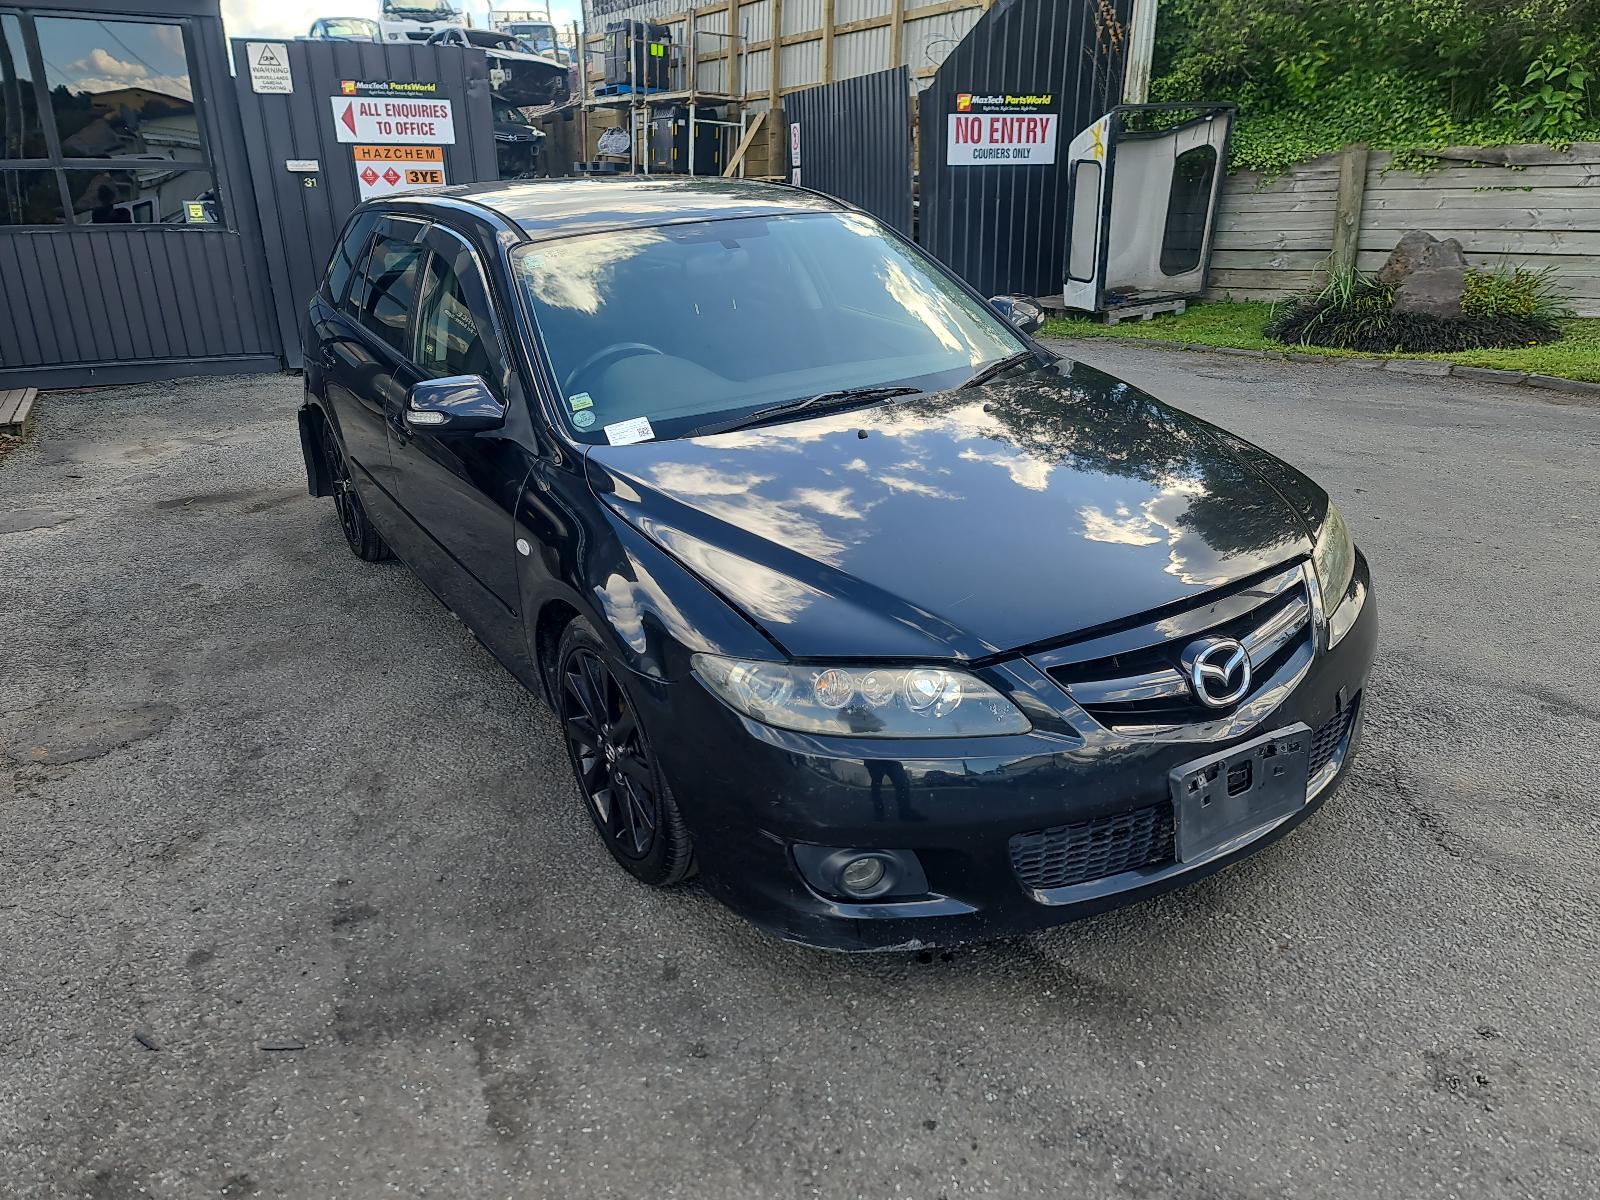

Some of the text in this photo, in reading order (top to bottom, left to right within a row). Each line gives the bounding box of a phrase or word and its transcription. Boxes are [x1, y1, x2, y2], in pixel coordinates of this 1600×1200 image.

[252, 66, 289, 74] WARNING
[389, 82, 436, 92] PartsWorld
[1004, 94, 1052, 105] PartsWorld
[360, 102, 448, 120] ALL ENQUIRIES
[376, 121, 436, 136] TO OFFICE
[955, 116, 1051, 145] NO ENTRY
[362, 148, 436, 160] HAZCHEM
[972, 147, 1031, 160] COURIERS ONLY
[303, 177, 317, 188] 31
[409, 170, 440, 183] 3YE
